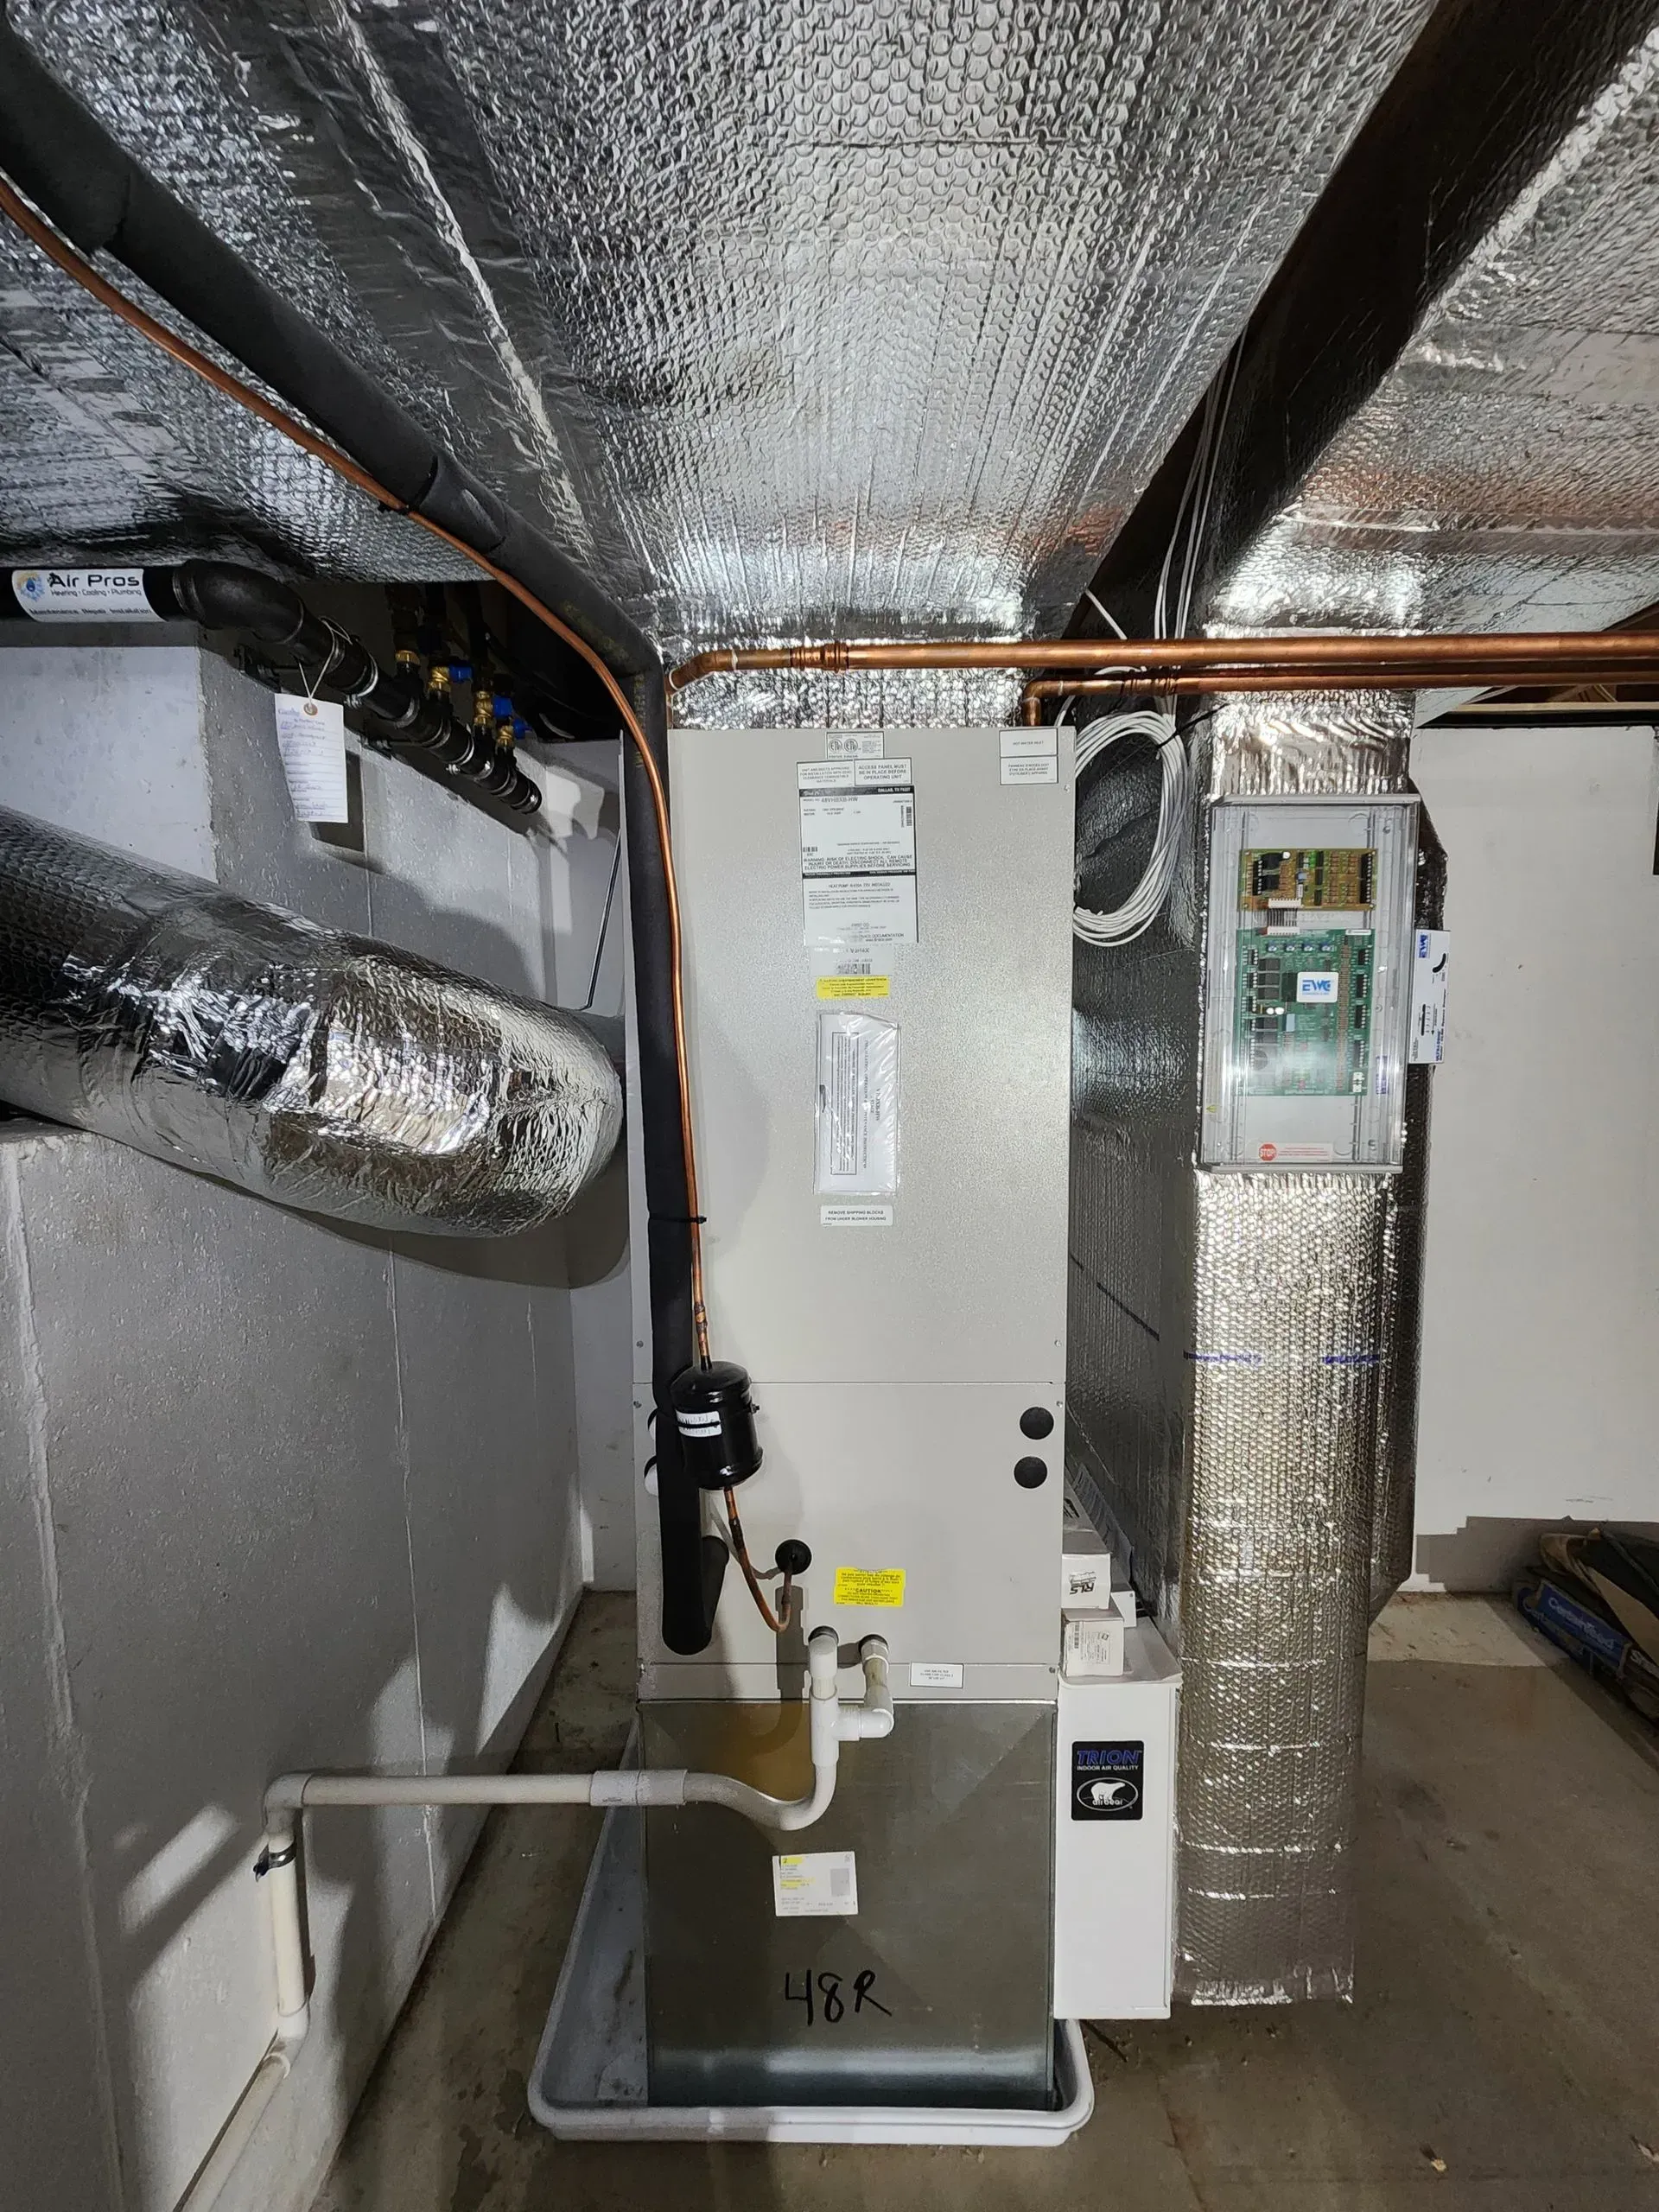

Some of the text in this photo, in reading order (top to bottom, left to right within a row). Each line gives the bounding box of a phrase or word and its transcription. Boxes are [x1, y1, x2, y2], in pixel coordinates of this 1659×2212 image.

[47, 572, 140, 588] Air Pros
[1302, 979, 1332, 992] EWC
[1069, 1581, 1095, 1595] RLS
[1077, 1749, 1140, 1765] TRION
[785, 1968, 893, 2026] 48R
